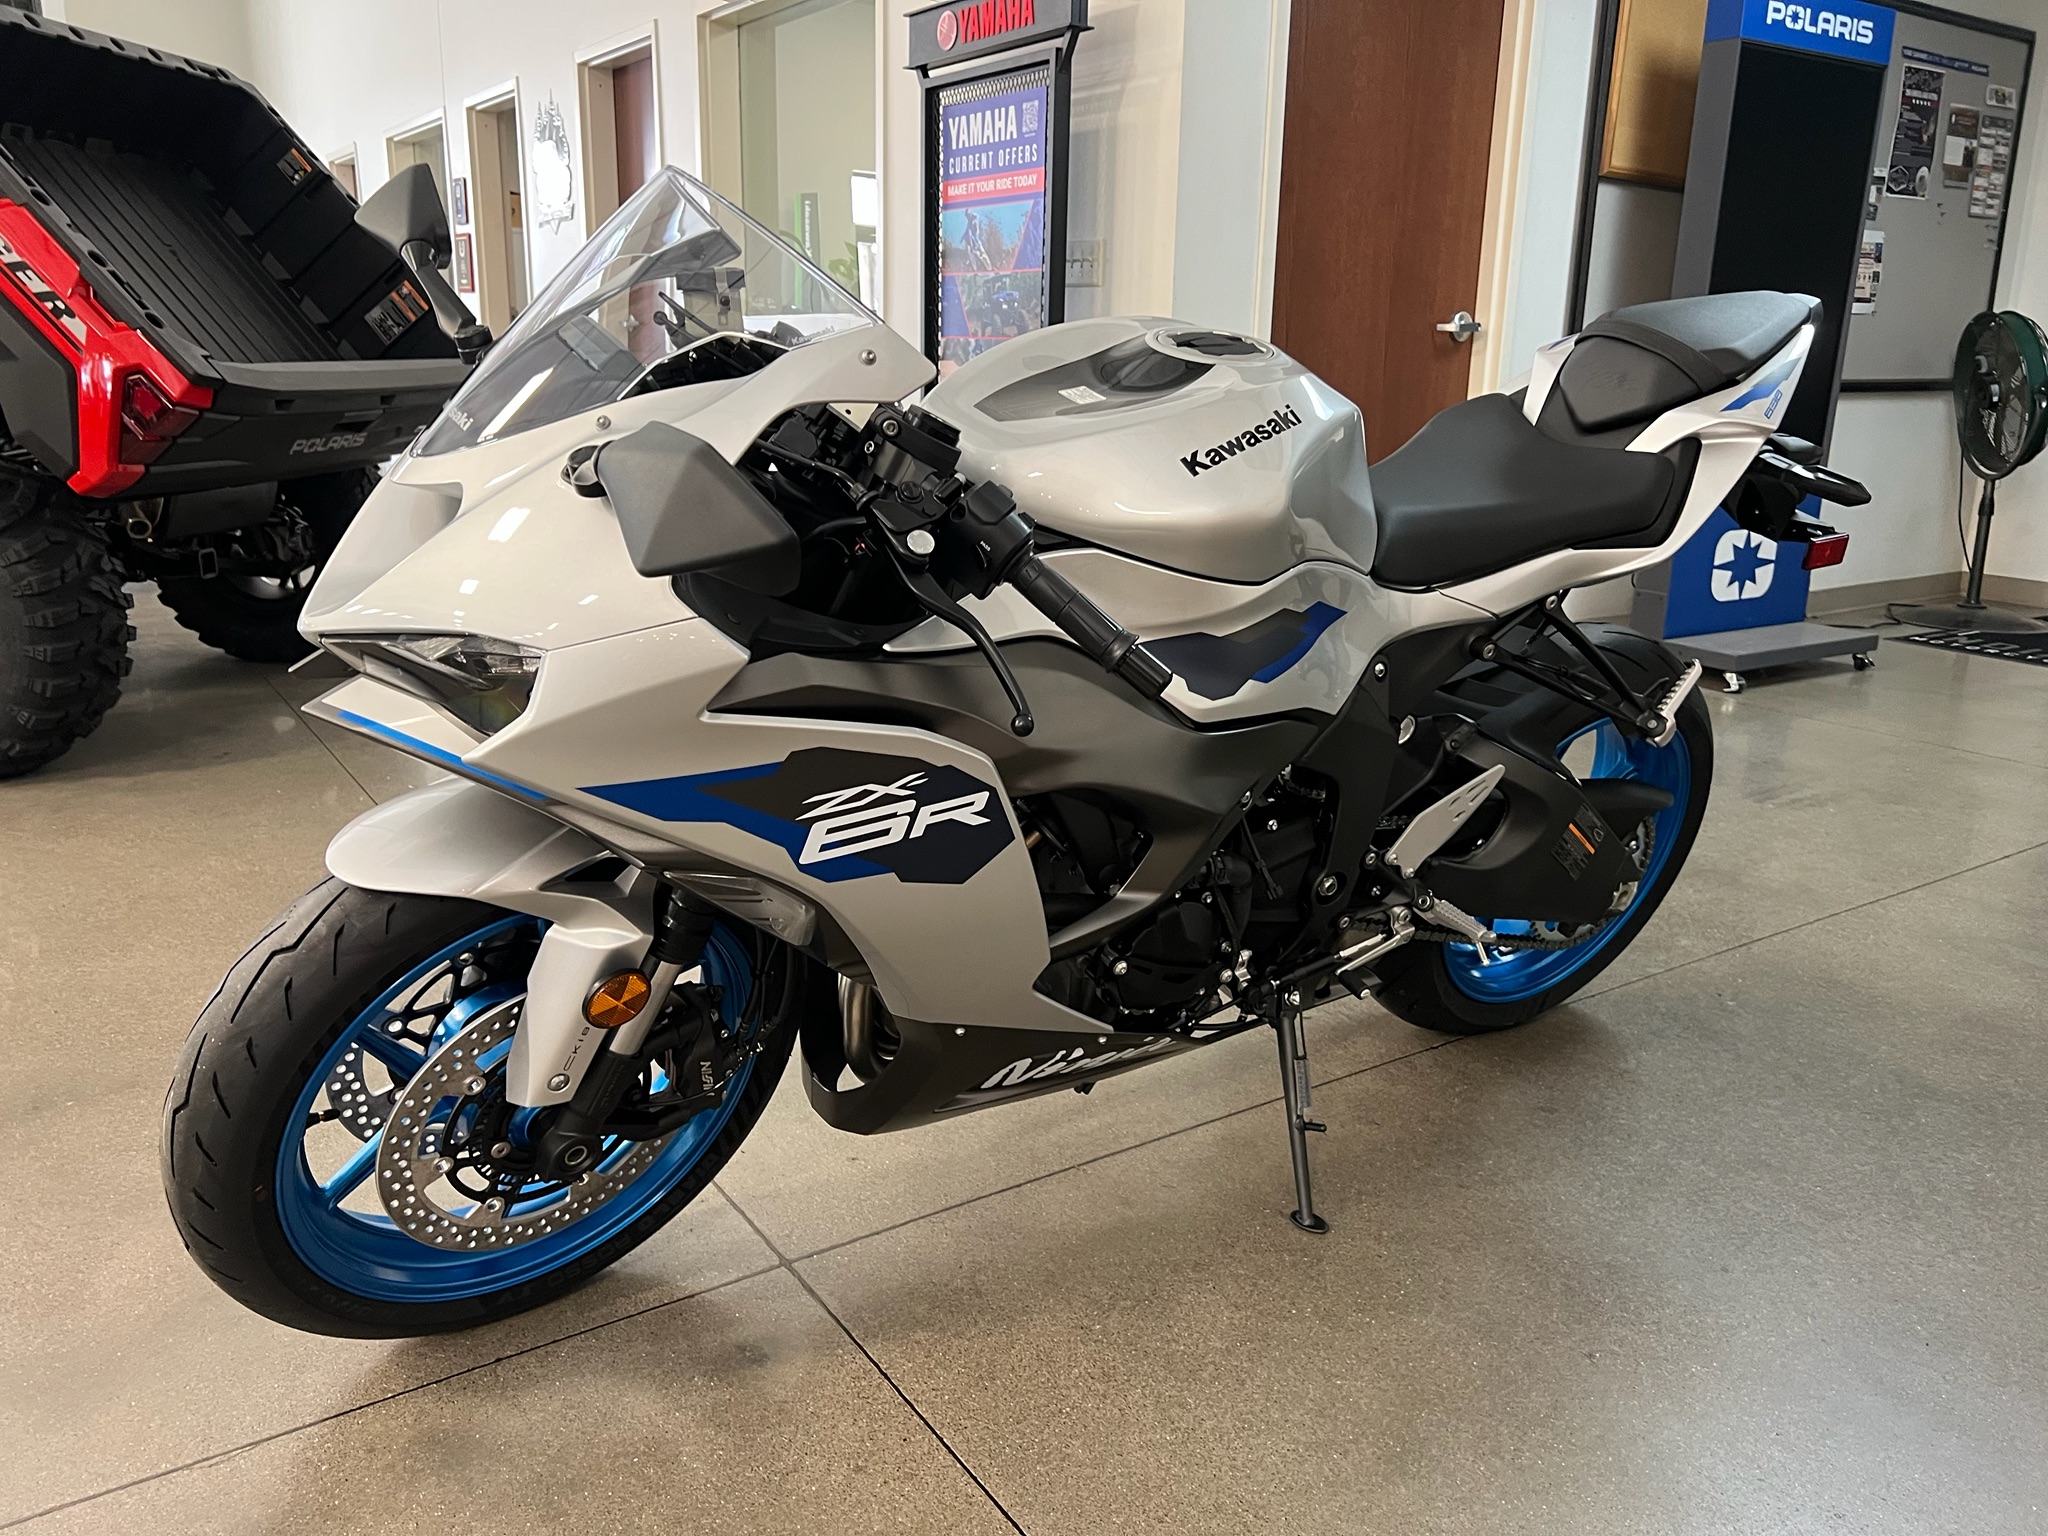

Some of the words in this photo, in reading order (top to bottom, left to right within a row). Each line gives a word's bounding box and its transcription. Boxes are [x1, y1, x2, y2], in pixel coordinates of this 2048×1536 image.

[958, 0, 1036, 44] YAMAHA
[1766, 0, 1875, 45] POLARIS
[948, 105, 1018, 150] YAMAHA
[948, 151, 994, 175] CURRENT
[998, 144, 1038, 167] OFFERS
[947, 180, 968, 197] MAKE
[968, 180, 976, 195] IT
[976, 178, 995, 194] YOUR
[996, 176, 1013, 192] RIDE
[1013, 173, 1037, 189] TODAY
[290, 432, 369, 455] POLARIS
[1179, 404, 1302, 477] Kawasaki
